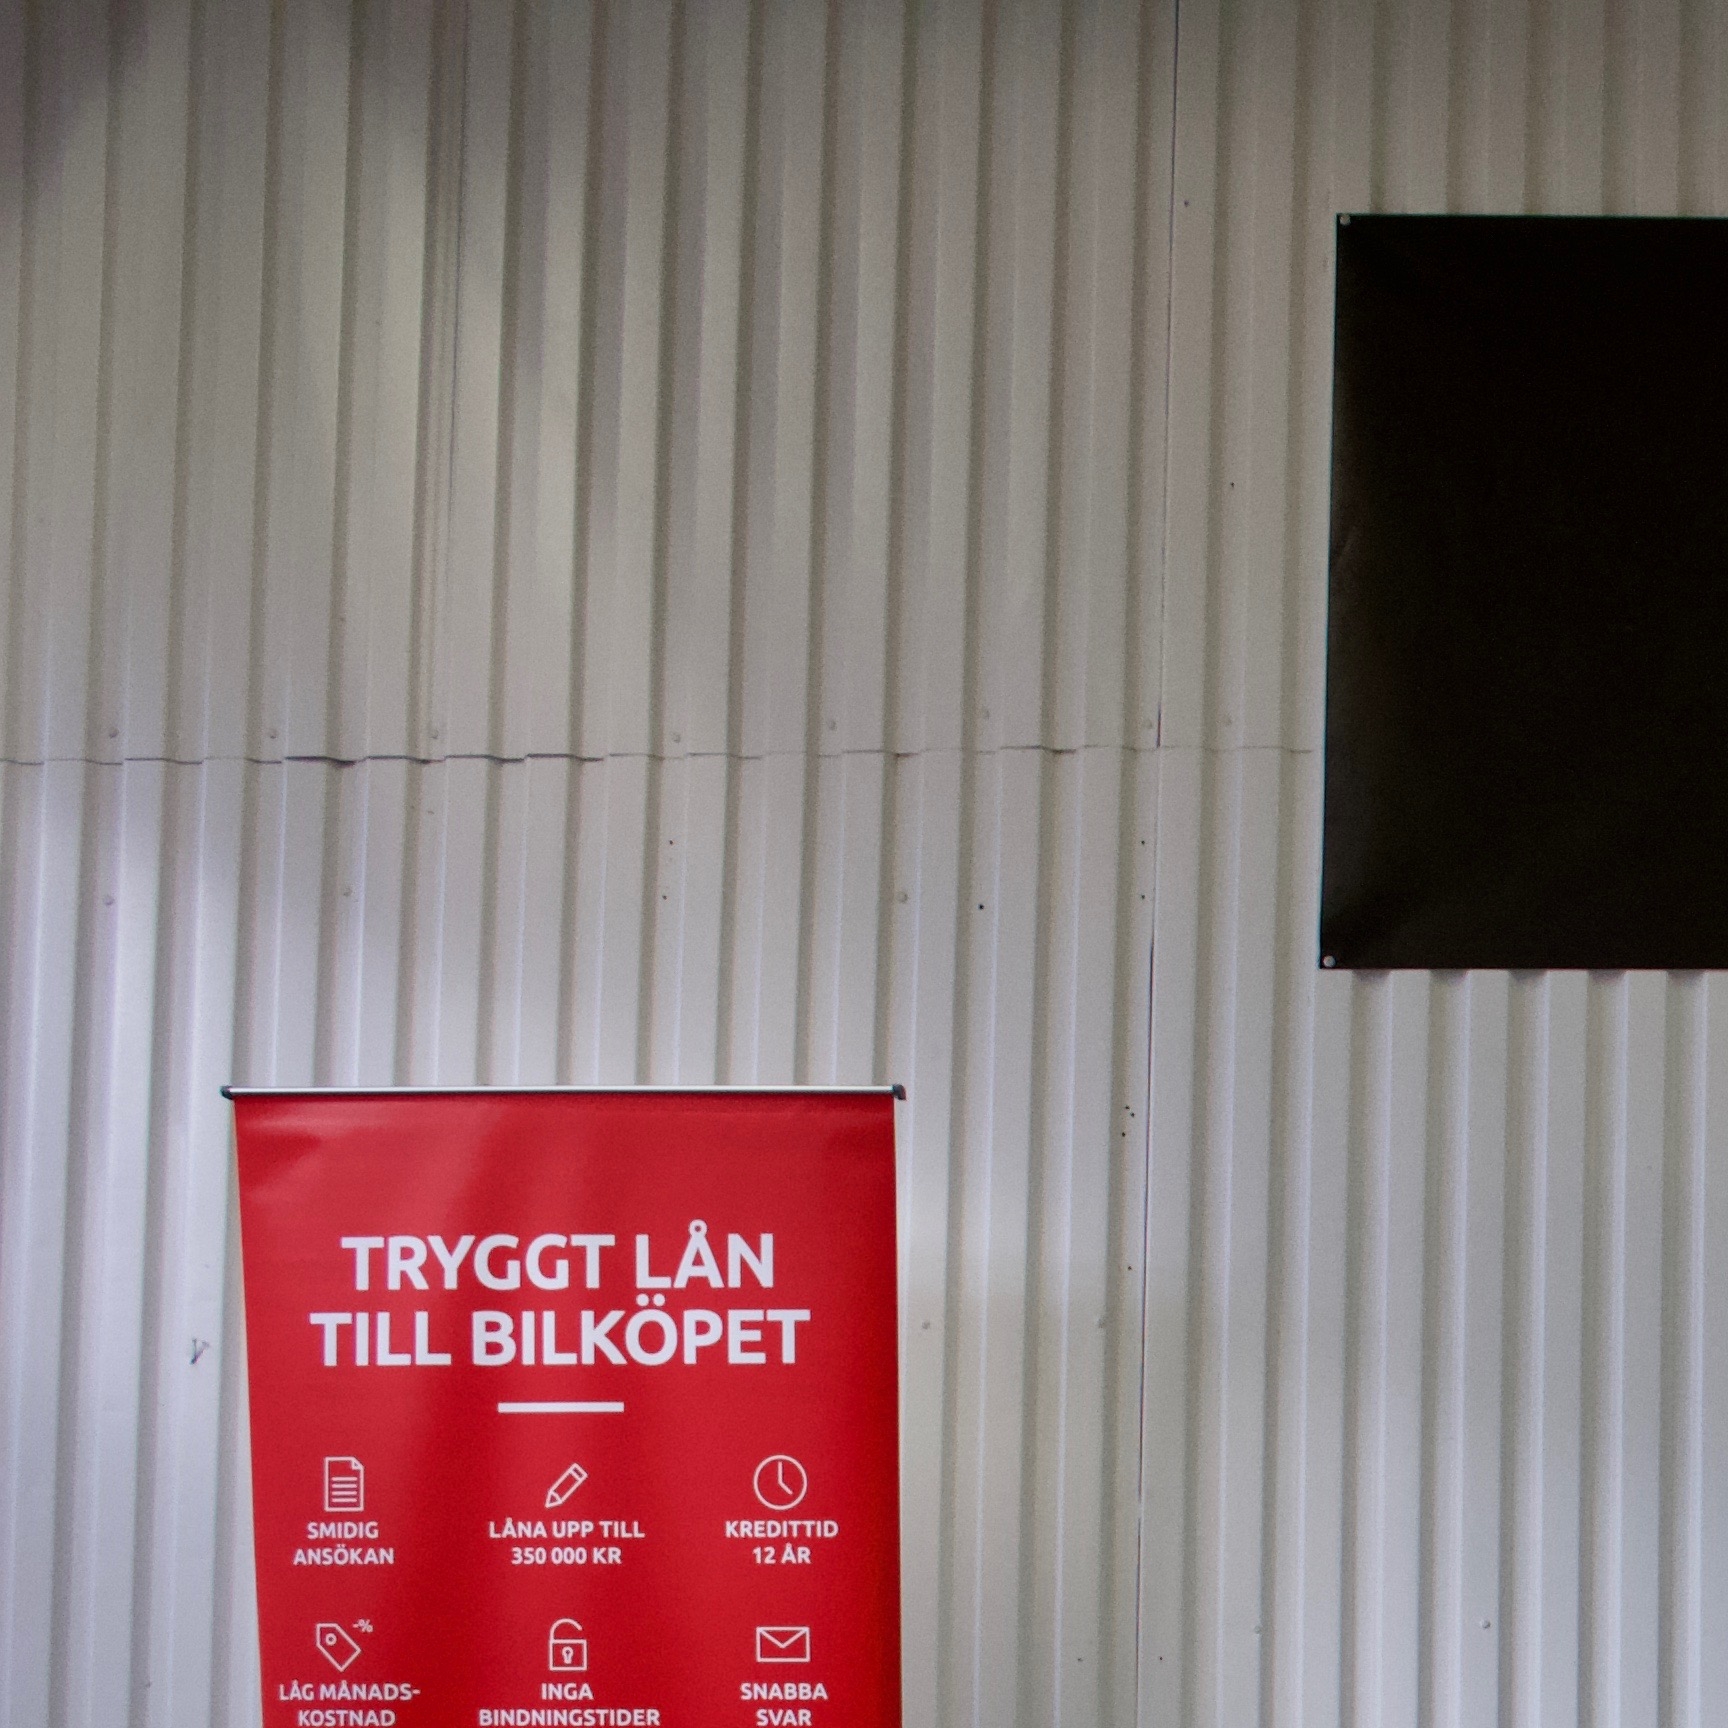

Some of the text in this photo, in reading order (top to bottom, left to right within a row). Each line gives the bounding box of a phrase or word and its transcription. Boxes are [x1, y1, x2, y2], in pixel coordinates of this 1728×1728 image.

[340, 1219, 774, 1292] TRYGGT LÅN
[309, 1292, 811, 1367] TILL BILKÖPET
[307, 1520, 379, 1540] SMIDIG
[489, 1517, 646, 1539] LÅNA UPP TILL
[725, 1519, 839, 1539] KREDITTID
[292, 1543, 395, 1566] ANSÖKAN
[511, 1546, 622, 1565] 350 000 KR
[752, 1542, 811, 1565] 12 ÅR
[279, 1679, 421, 1701] LÅG MÅNADS-
[541, 1682, 594, 1701] INGA
[739, 1682, 829, 1701] SNABBA
[297, 1709, 396, 1728] KOSTNAD
[478, 1708, 661, 1727] BINDNINGSTIDER
[755, 1708, 812, 1727] SVAR
